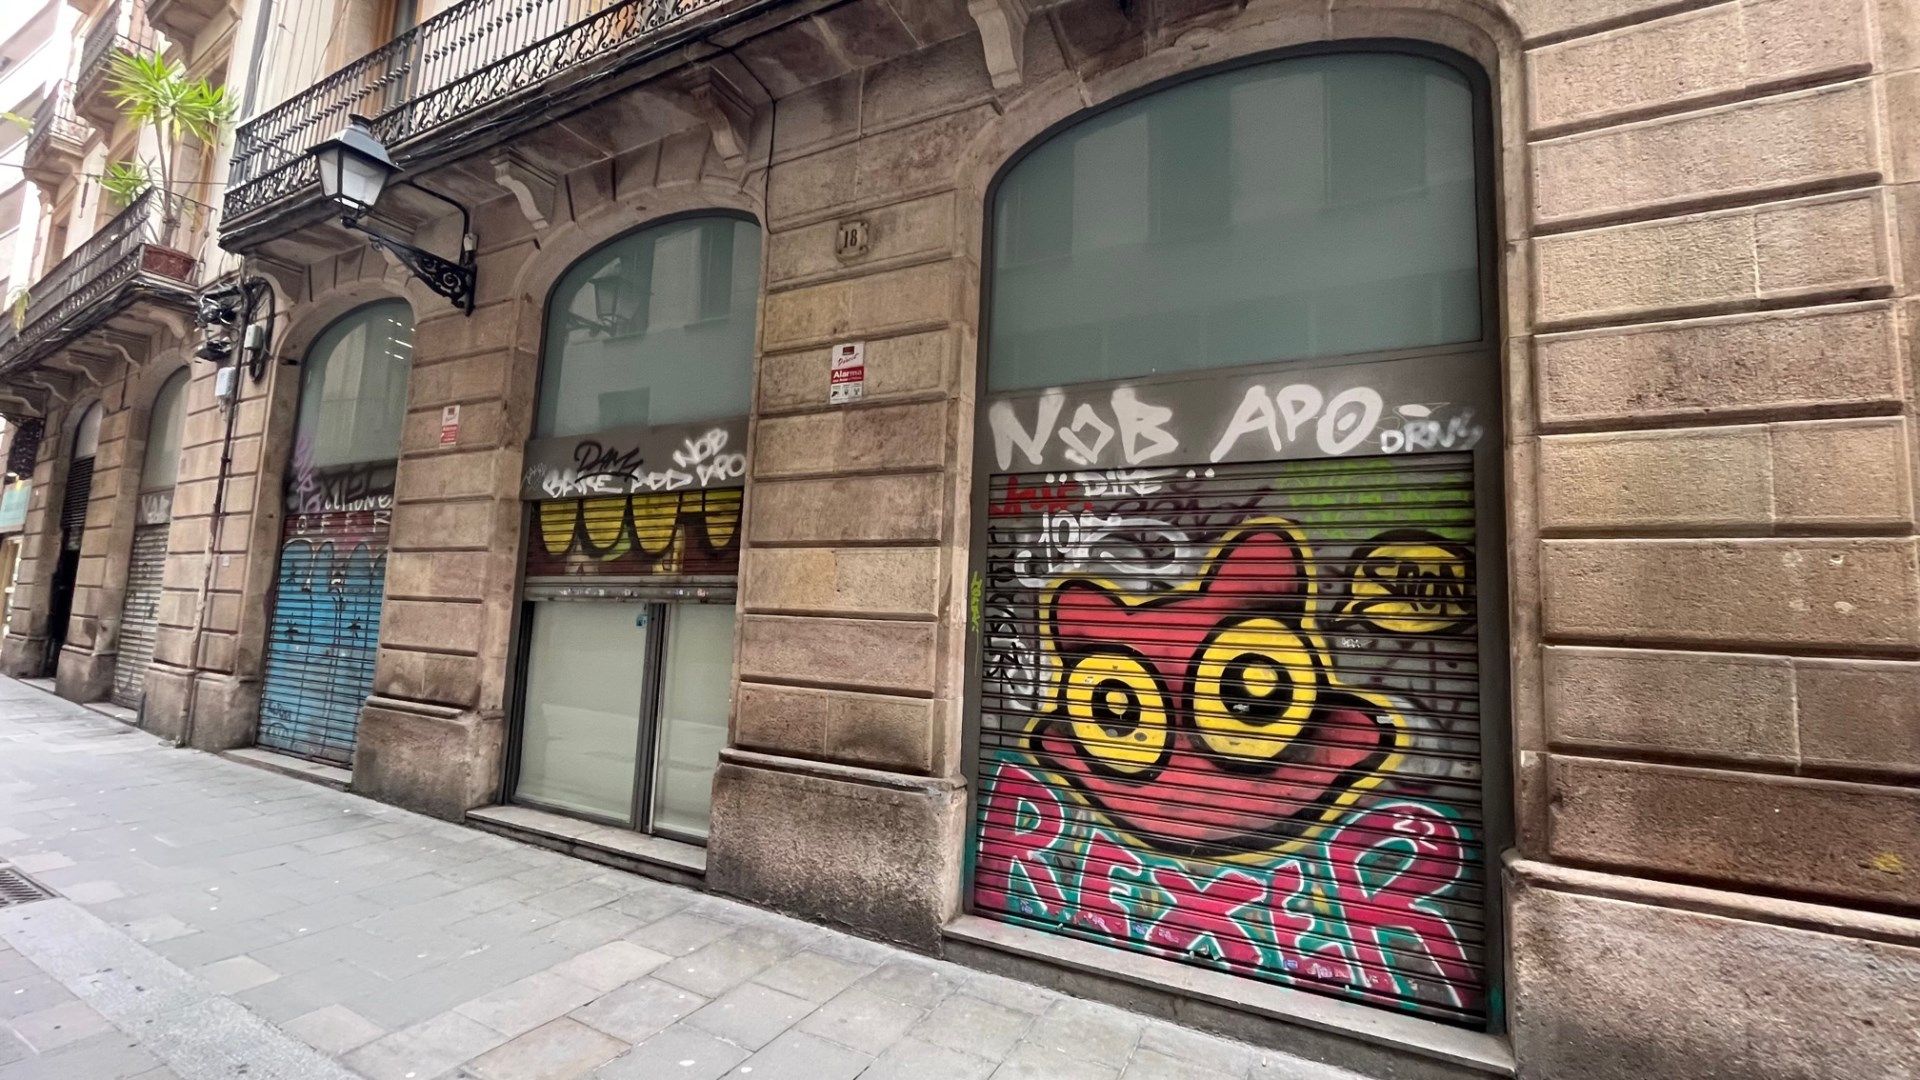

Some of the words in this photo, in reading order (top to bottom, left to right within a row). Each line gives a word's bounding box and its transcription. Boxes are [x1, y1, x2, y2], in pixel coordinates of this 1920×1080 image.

[843, 229, 858, 249] 18
[989, 386, 1179, 471] NOB
[1210, 384, 1384, 463] APO
